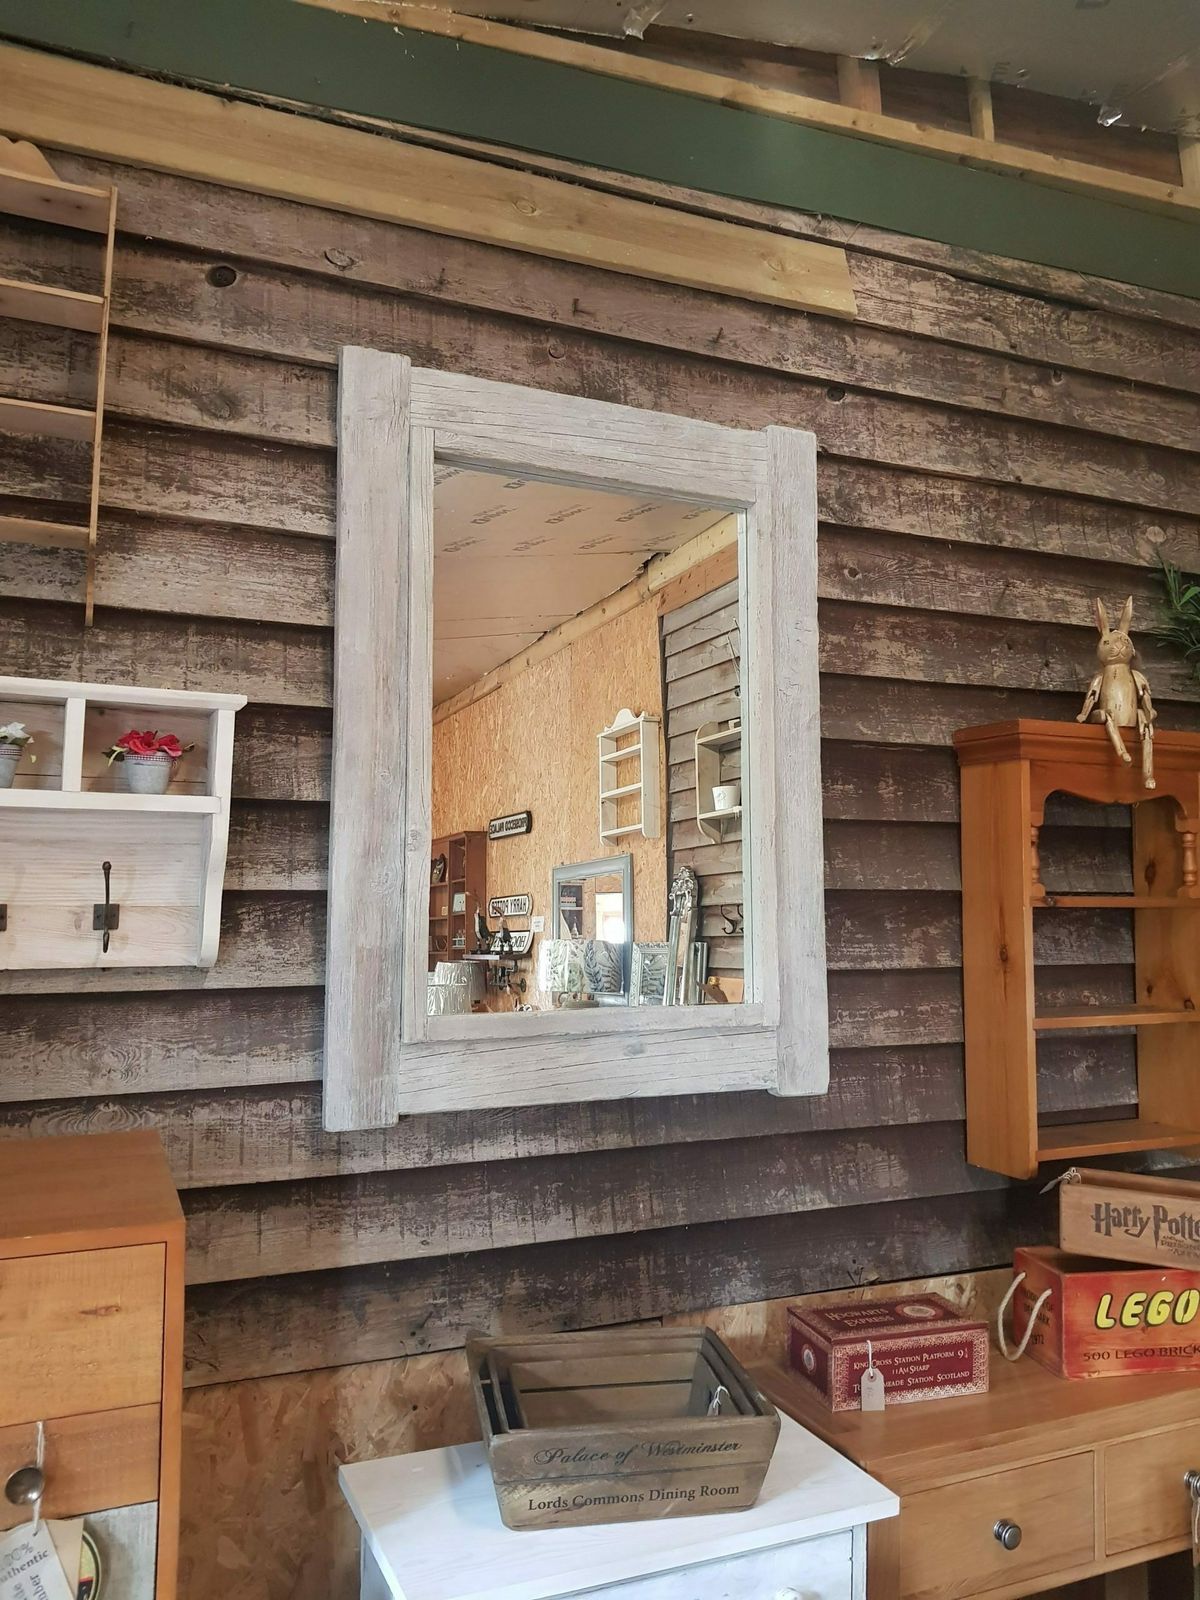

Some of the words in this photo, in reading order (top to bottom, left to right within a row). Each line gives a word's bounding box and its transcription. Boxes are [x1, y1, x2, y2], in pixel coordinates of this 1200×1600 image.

[1090, 1202, 1151, 1238] Harry
[1095, 1287, 1200, 1329] LEGO
[844, 1316, 895, 1327] EXPRESS
[894, 1356, 920, 1366] STATION
[922, 1352, 955, 1363] PLATFORM
[1083, 1351, 1111, 1361] 500
[1115, 1348, 1155, 1359] LEGO
[907, 1376, 934, 1387] STATION
[937, 1370, 970, 1382] SCOTLAND
[533, 1446, 609, 1466] Palace
[614, 1443, 640, 1466] of
[641, 1440, 743, 1457] Westminster
[528, 1496, 569, 1511] Lords
[572, 1493, 644, 1507] Commons
[649, 1487, 696, 1502] Dining
[700, 1485, 740, 1497] Room
